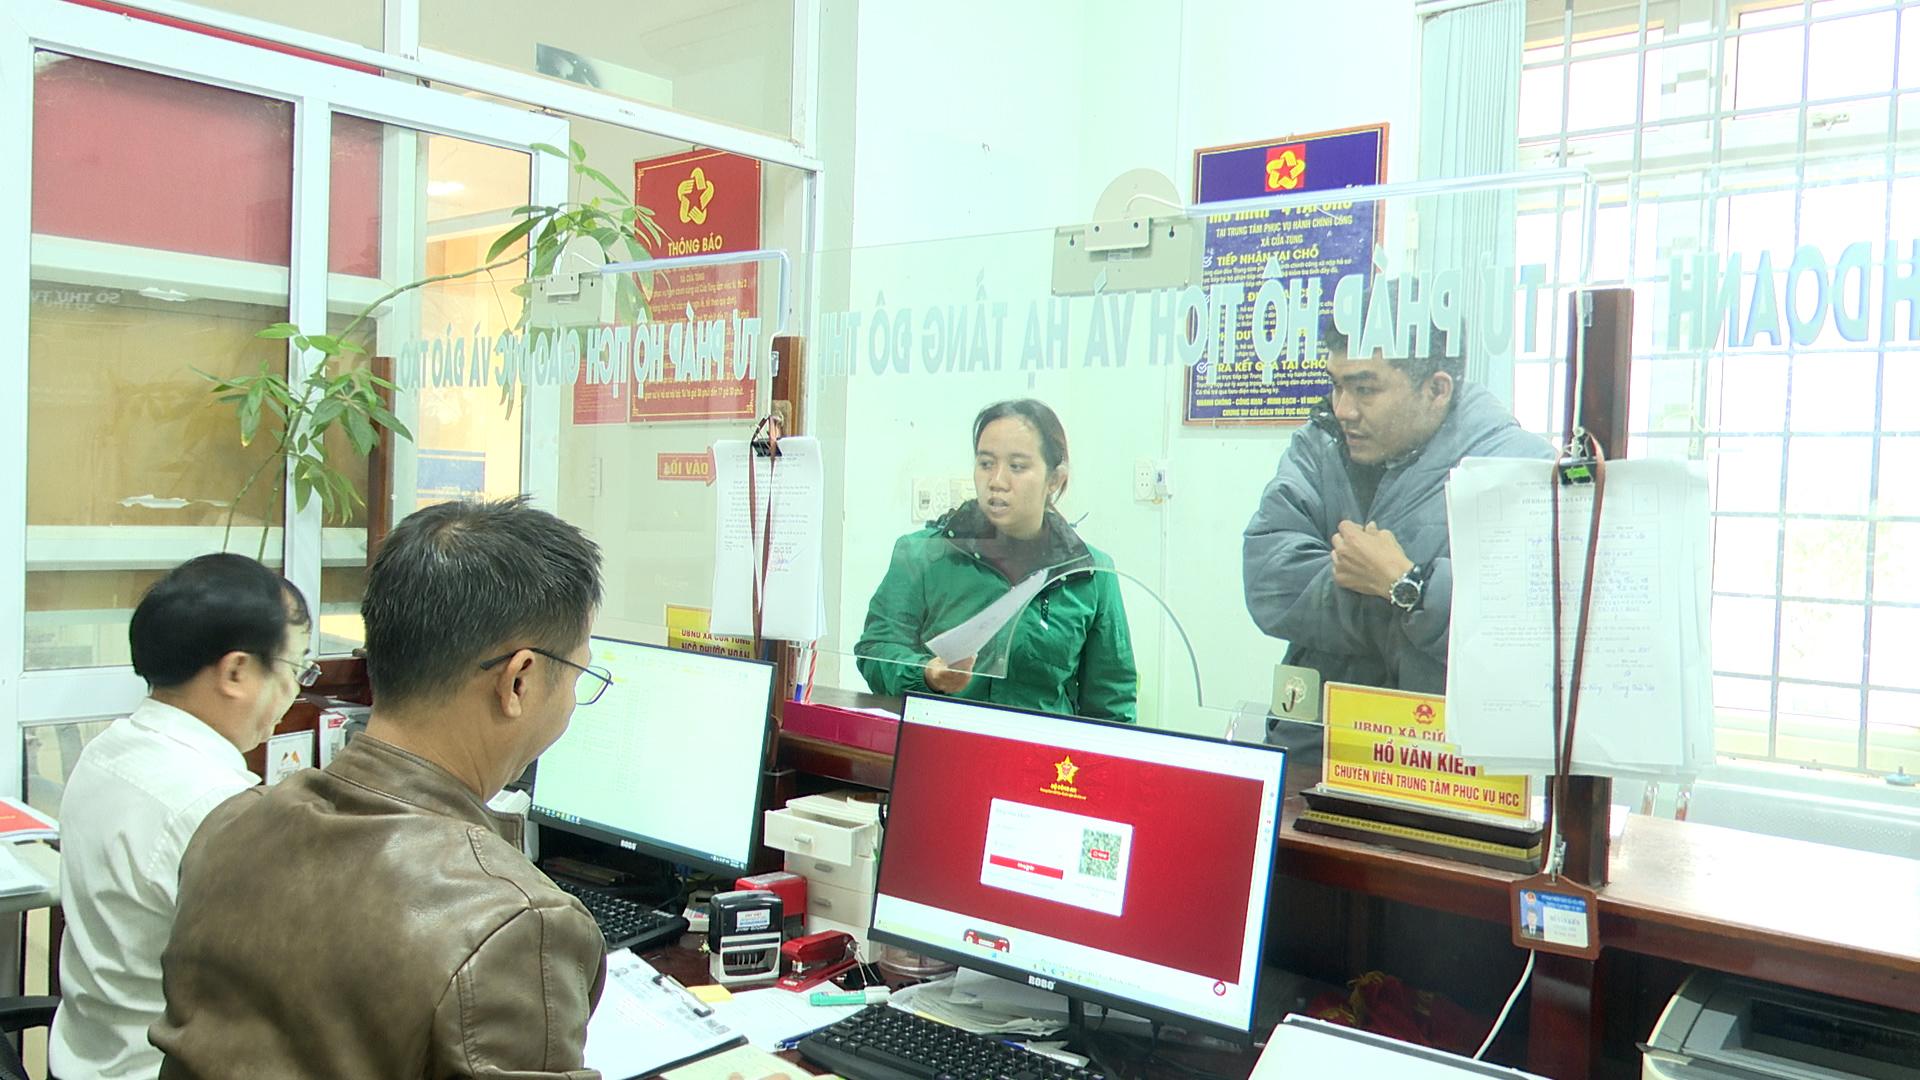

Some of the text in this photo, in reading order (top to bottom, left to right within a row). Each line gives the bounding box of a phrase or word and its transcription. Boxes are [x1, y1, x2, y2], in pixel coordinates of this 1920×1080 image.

[1228, 226, 1248, 237] TRUNG
[668, 232, 723, 256] THÔNG BÁO
[1216, 251, 1238, 267] TIẾP
[1240, 250, 1271, 266] NHẬN
[1292, 243, 1319, 260] CHỖ
[1281, 360, 1299, 373] TẠI
[686, 459, 708, 475] VÀO
[1354, 721, 1393, 735] UBND
[1422, 728, 1446, 743] CỬ
[1400, 743, 1432, 770] VĂN
[1334, 763, 1519, 807] CHUYÊN VIÊN TRUNG TÂM PHỤC VỤ HCC
